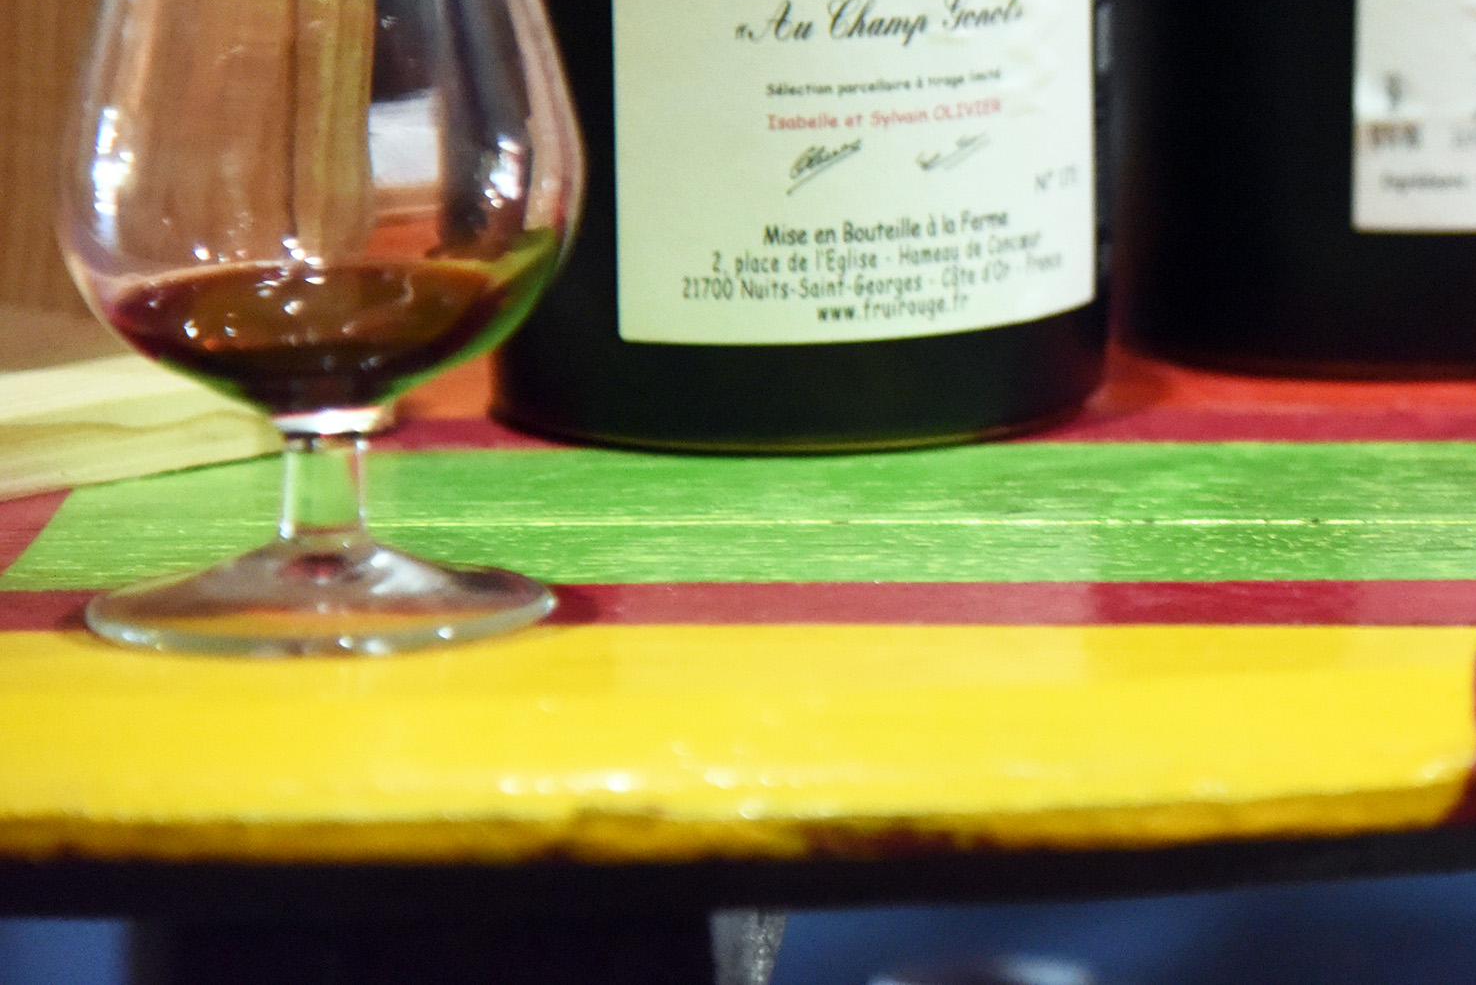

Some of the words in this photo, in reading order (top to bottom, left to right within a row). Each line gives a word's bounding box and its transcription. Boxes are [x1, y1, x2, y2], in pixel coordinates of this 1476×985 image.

[766, 81, 833, 98] Sélection
[836, 77, 912, 97] parcellaire
[767, 112, 839, 131] Isabelle
[843, 112, 864, 130] et
[869, 107, 929, 132] Sylvain
[932, 96, 1002, 123] OLIVIER
[763, 224, 808, 246] Mise
[813, 227, 837, 245] en
[842, 216, 921, 245] Bouteille
[926, 213, 937, 238] à
[942, 213, 956, 235] la
[960, 209, 1009, 234] Ferme
[734, 250, 780, 277] place
[788, 251, 808, 274] de
[682, 275, 734, 301] 21700
[739, 274, 922, 302] Nuits-Saint-Georges
